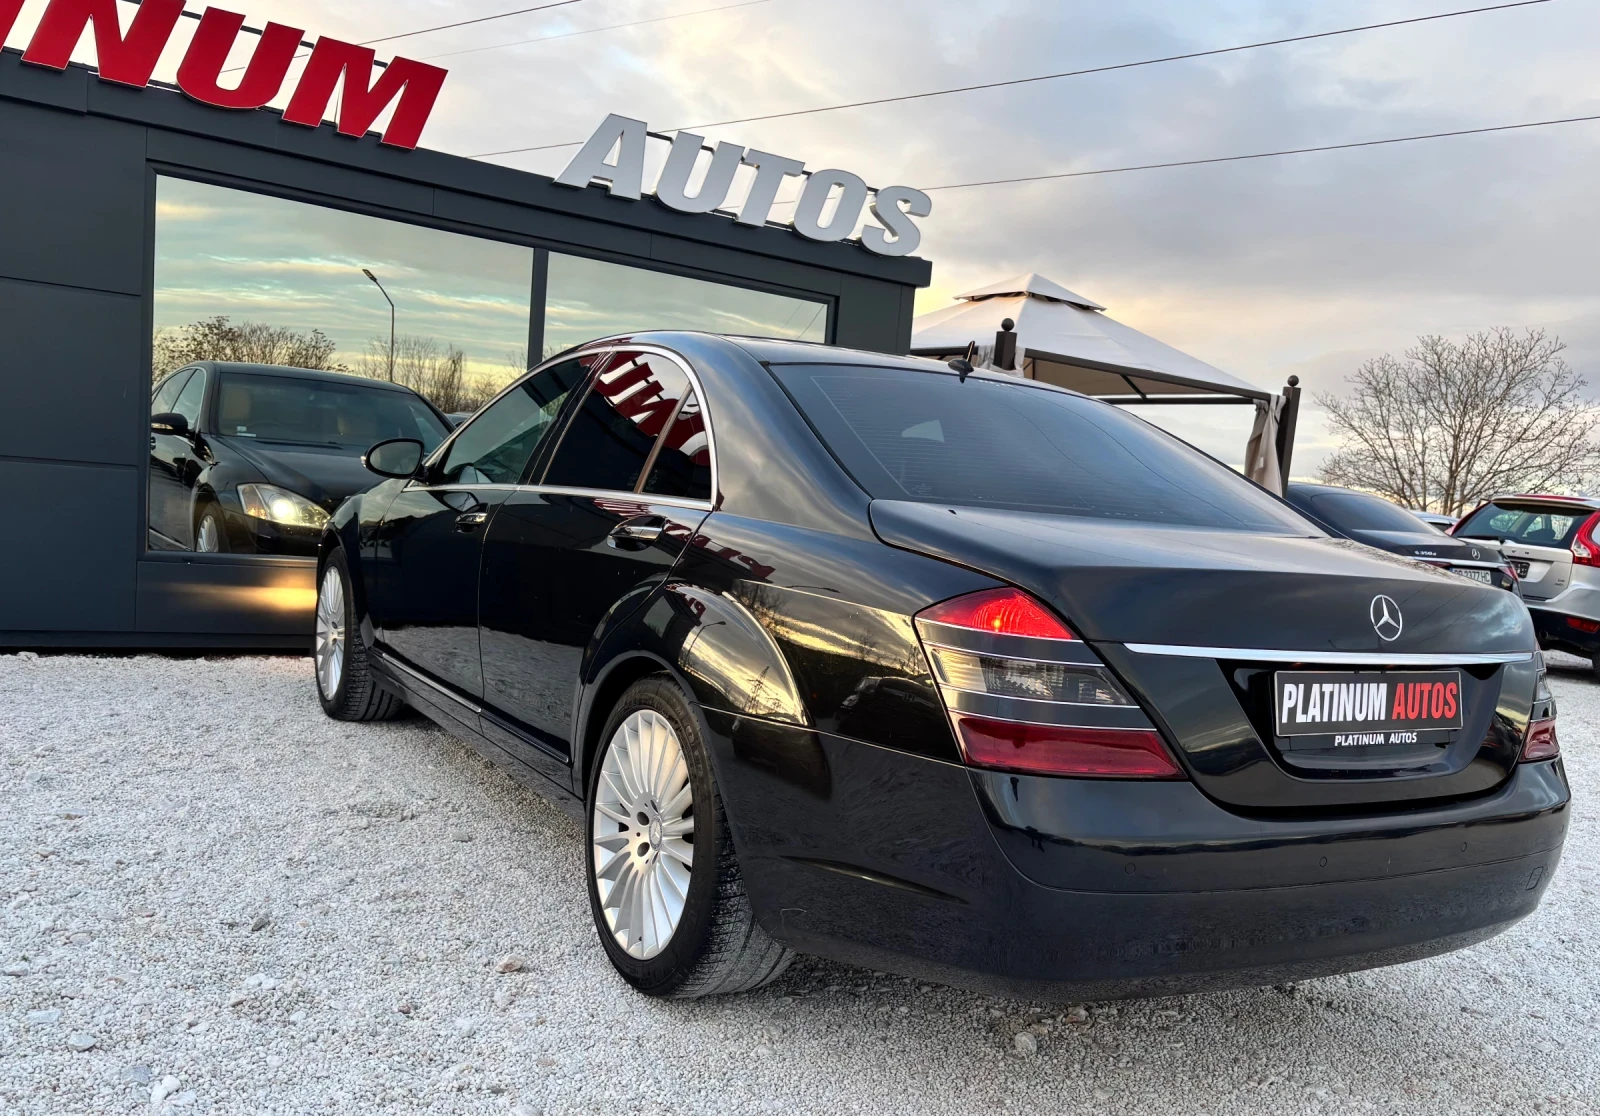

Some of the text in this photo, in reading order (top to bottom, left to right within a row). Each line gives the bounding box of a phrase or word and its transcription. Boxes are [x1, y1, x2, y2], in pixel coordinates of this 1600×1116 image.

[552, 113, 932, 257] AUTOS
[1281, 681, 1458, 724] PLATINUM AUTOS
[1334, 732, 1418, 747] PLATINUM AUTOS
